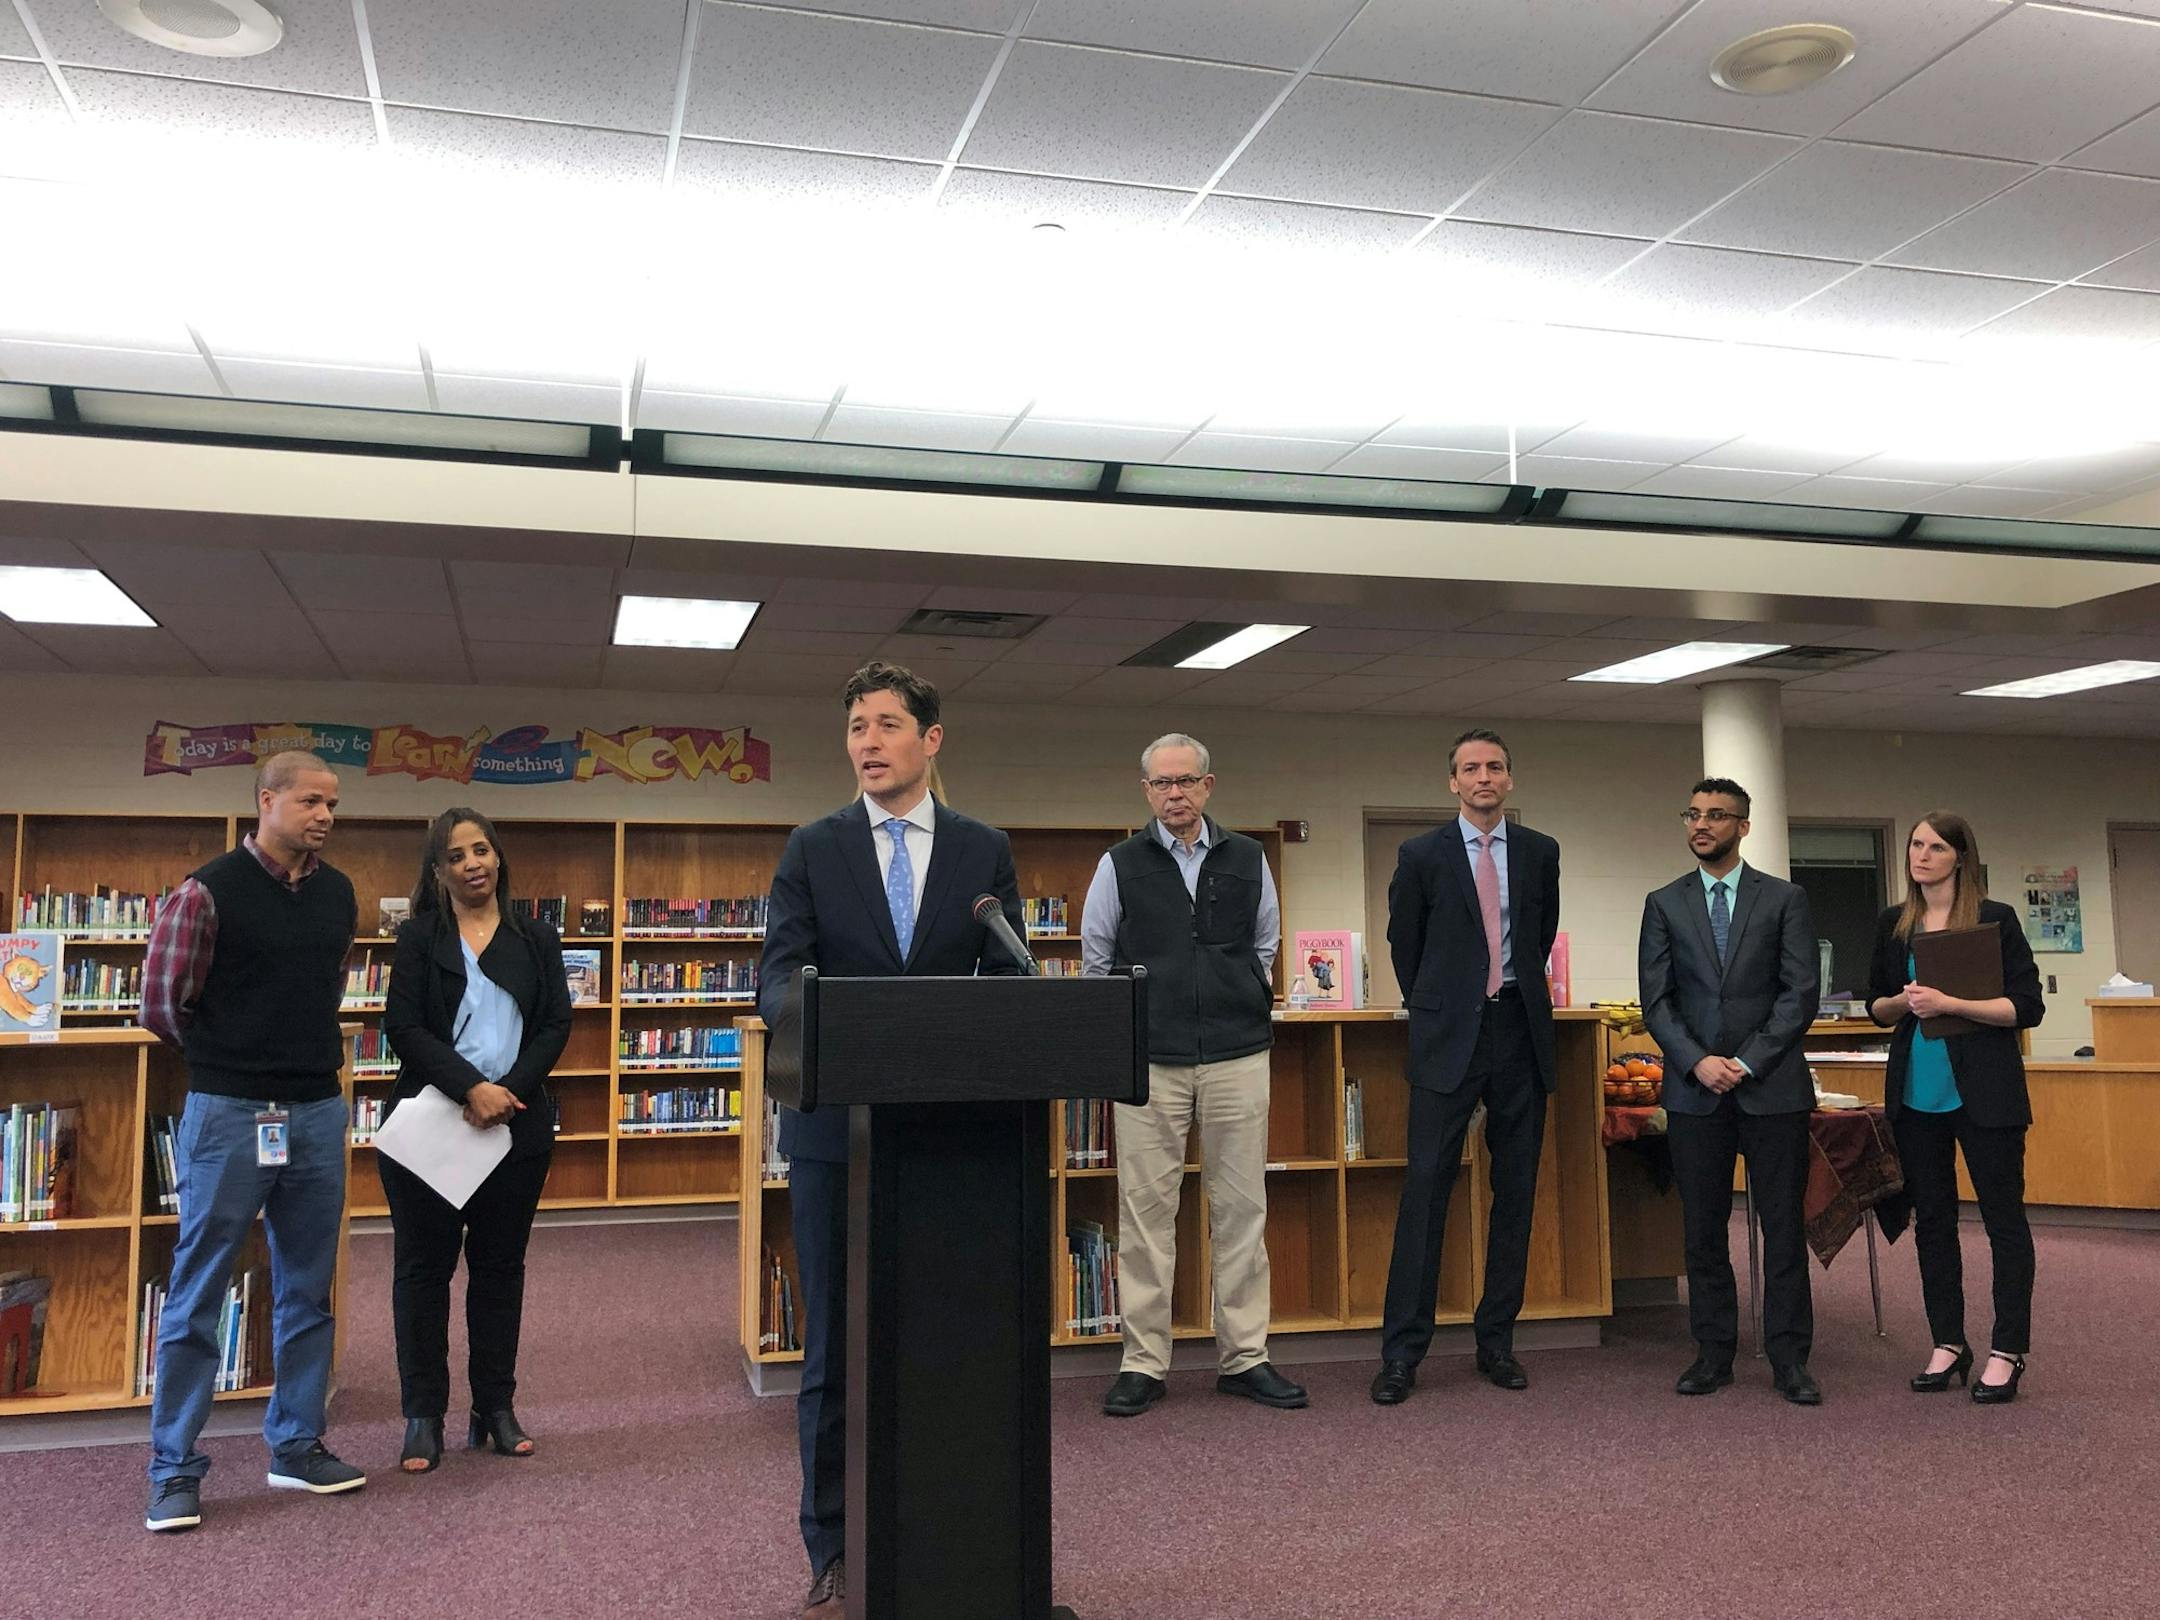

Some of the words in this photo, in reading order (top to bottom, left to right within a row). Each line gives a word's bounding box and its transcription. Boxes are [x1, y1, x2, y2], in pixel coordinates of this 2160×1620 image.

[157, 727, 217, 767] Today
[224, 735, 237, 751] is
[242, 739, 251, 751] a
[257, 735, 308, 753] great
[314, 732, 346, 752] day
[352, 735, 372, 752] to
[473, 754, 564, 773] something
